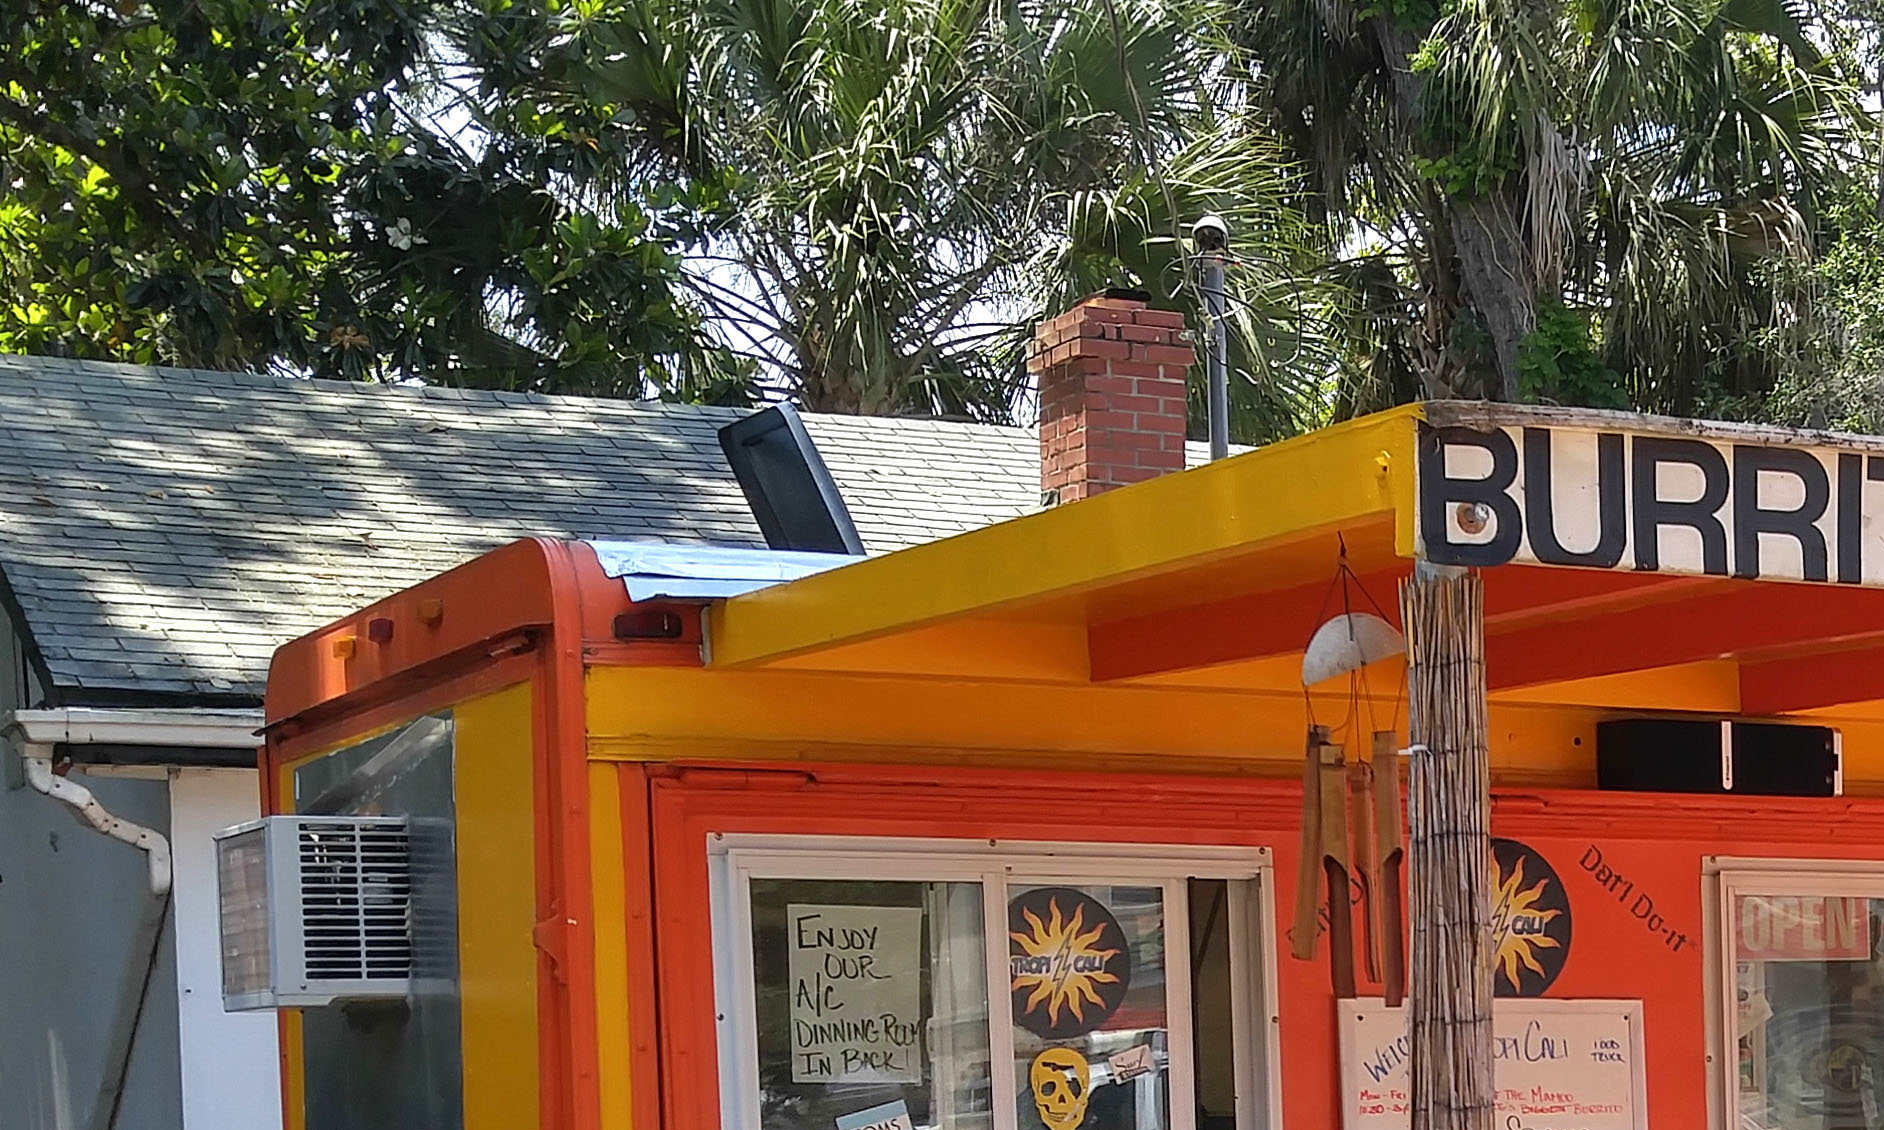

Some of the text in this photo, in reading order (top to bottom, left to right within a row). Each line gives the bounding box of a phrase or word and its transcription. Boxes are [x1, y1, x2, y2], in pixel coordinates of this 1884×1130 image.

[797, 914, 878, 950] ENJOY
[1512, 915, 1546, 936] CALI
[1742, 896, 1858, 951] OPEN
[825, 953, 892, 979] OUR
[1011, 955, 1104, 974] TROPI CALI
[796, 972, 844, 1017] A/C
[793, 1018, 879, 1047] DINNING
[799, 1052, 832, 1075] IN
